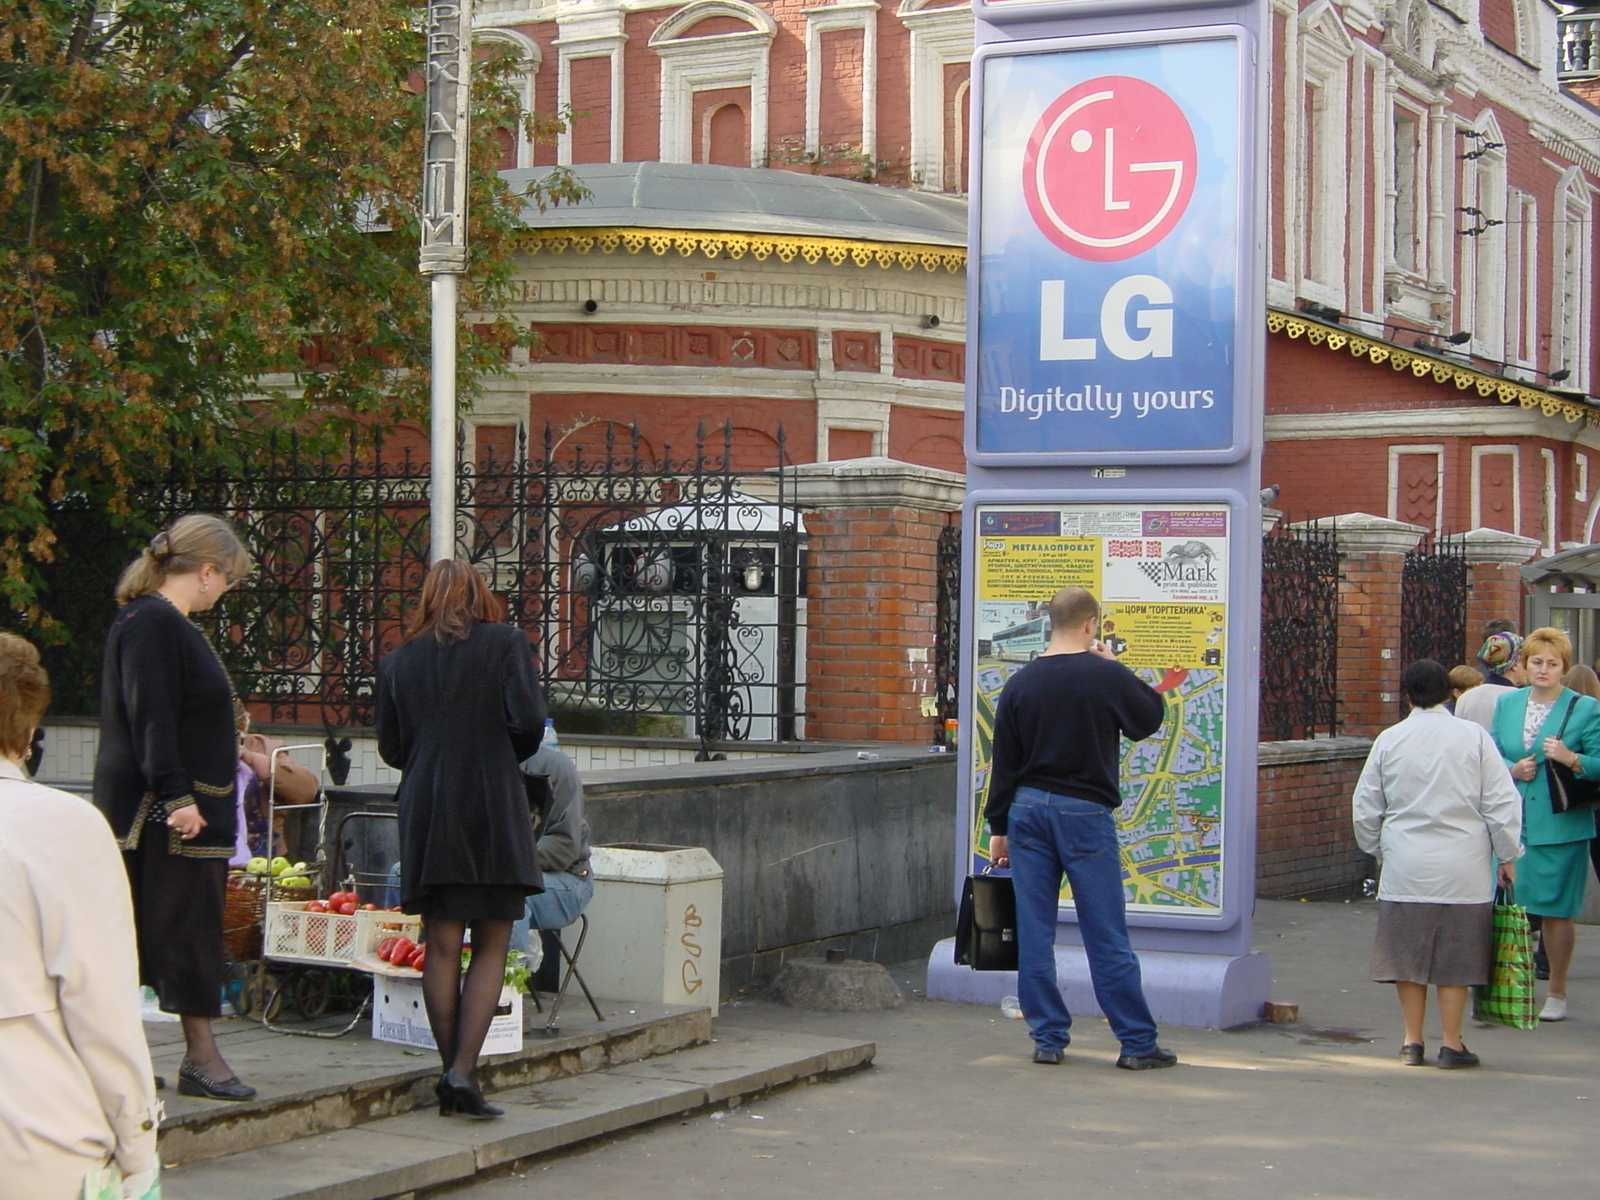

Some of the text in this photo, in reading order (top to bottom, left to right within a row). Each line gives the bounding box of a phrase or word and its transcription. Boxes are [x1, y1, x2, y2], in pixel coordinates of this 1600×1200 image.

[1040, 275, 1174, 362] LG
[1000, 385, 1216, 420] Digitally yours
[1163, 562, 1217, 582] Mark
[1125, 605, 1147, 615] ЦОРМ
[1148, 605, 1207, 615] "ТОРГТЕХНИКА"
